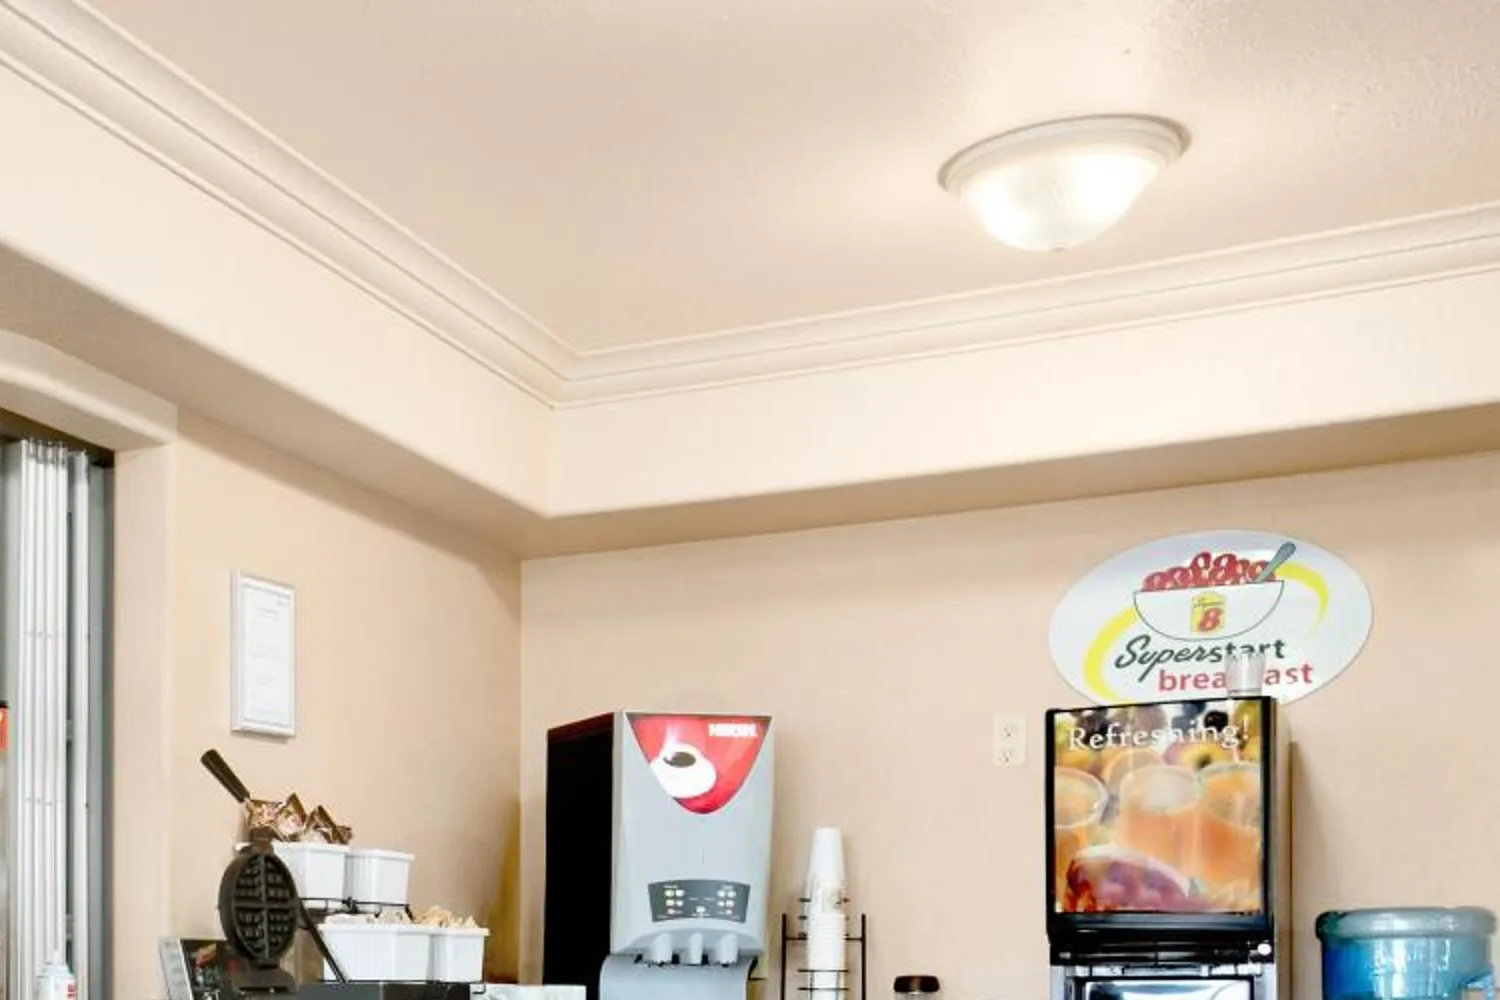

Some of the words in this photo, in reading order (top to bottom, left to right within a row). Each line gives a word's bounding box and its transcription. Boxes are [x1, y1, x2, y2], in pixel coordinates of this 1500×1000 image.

[1197, 607, 1223, 632] 8
[1158, 663, 1314, 692] breaast
[1068, 716, 1250, 750] Refreshing!
